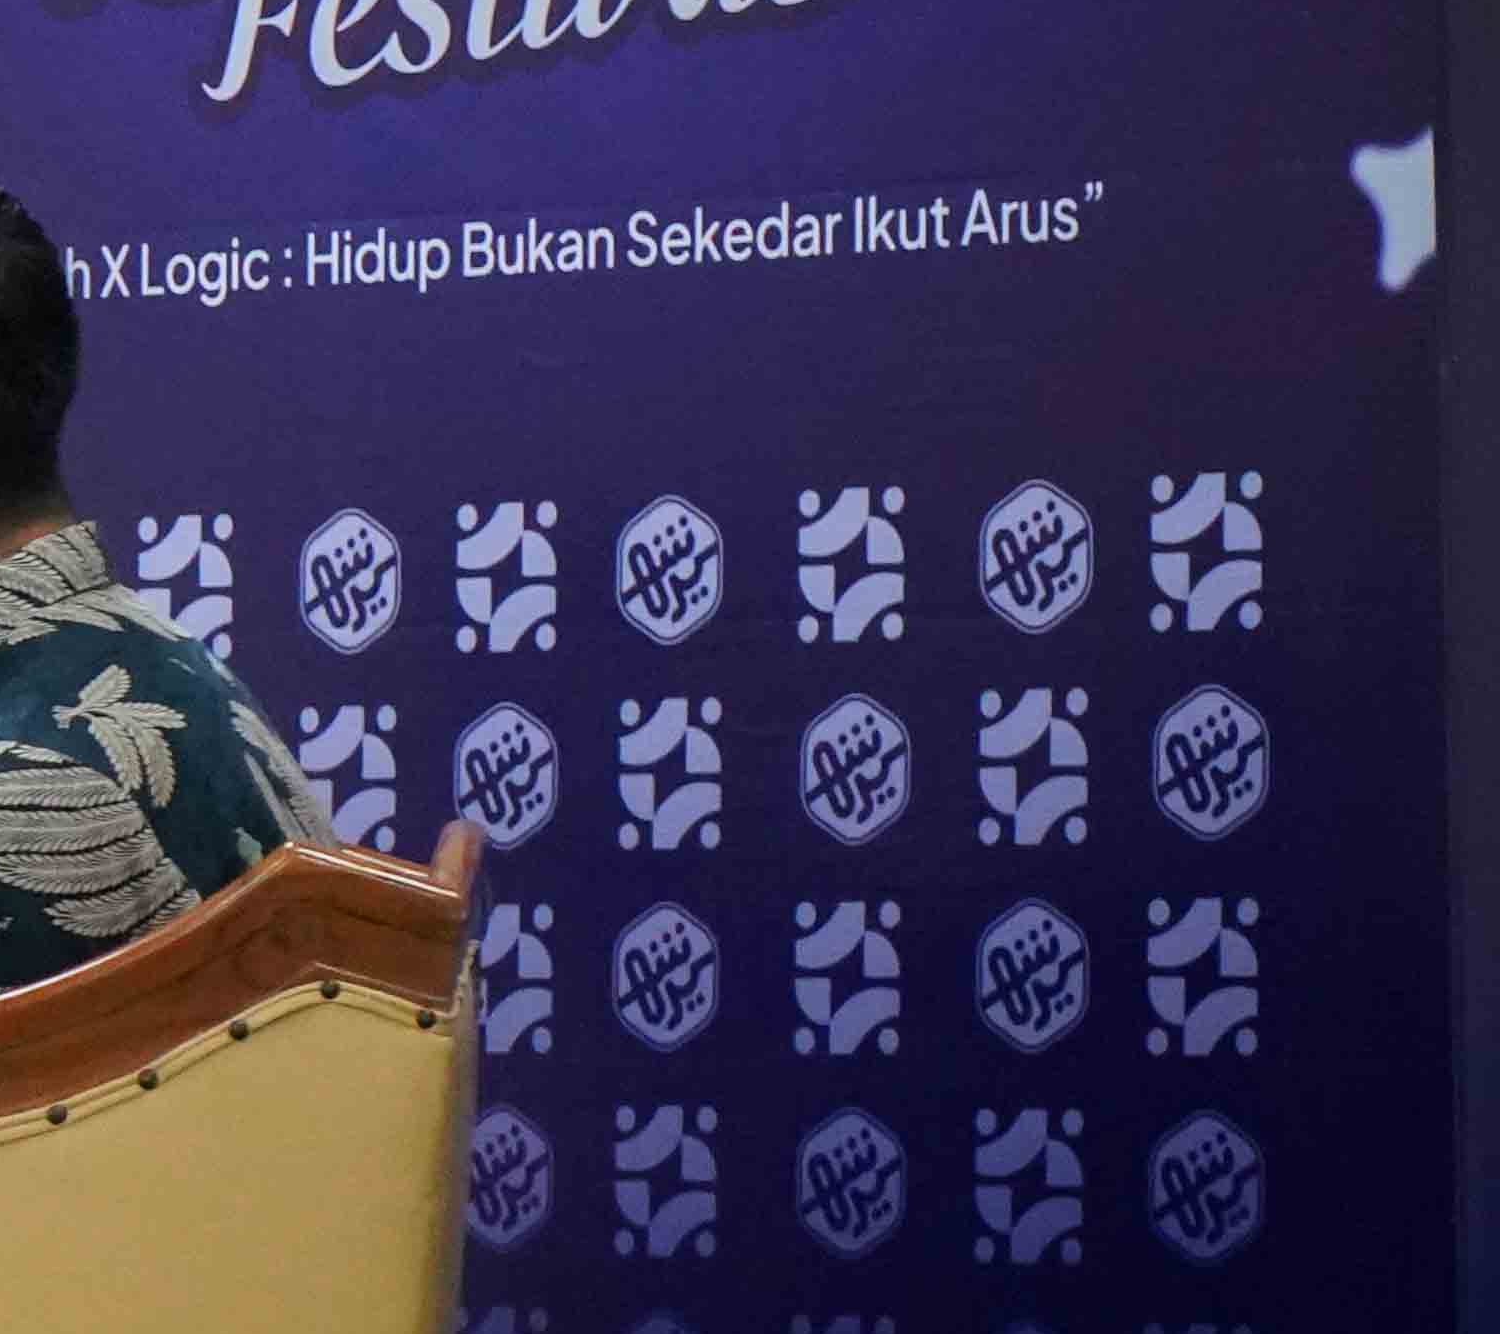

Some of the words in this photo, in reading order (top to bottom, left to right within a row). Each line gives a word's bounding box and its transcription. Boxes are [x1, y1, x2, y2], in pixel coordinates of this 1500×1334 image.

[100, 243, 131, 299] X
[140, 235, 271, 308] Logic
[307, 226, 451, 294] Hidup
[462, 217, 615, 277] Bukan
[627, 201, 843, 268] Sekedar
[854, 195, 950, 253] Ikut
